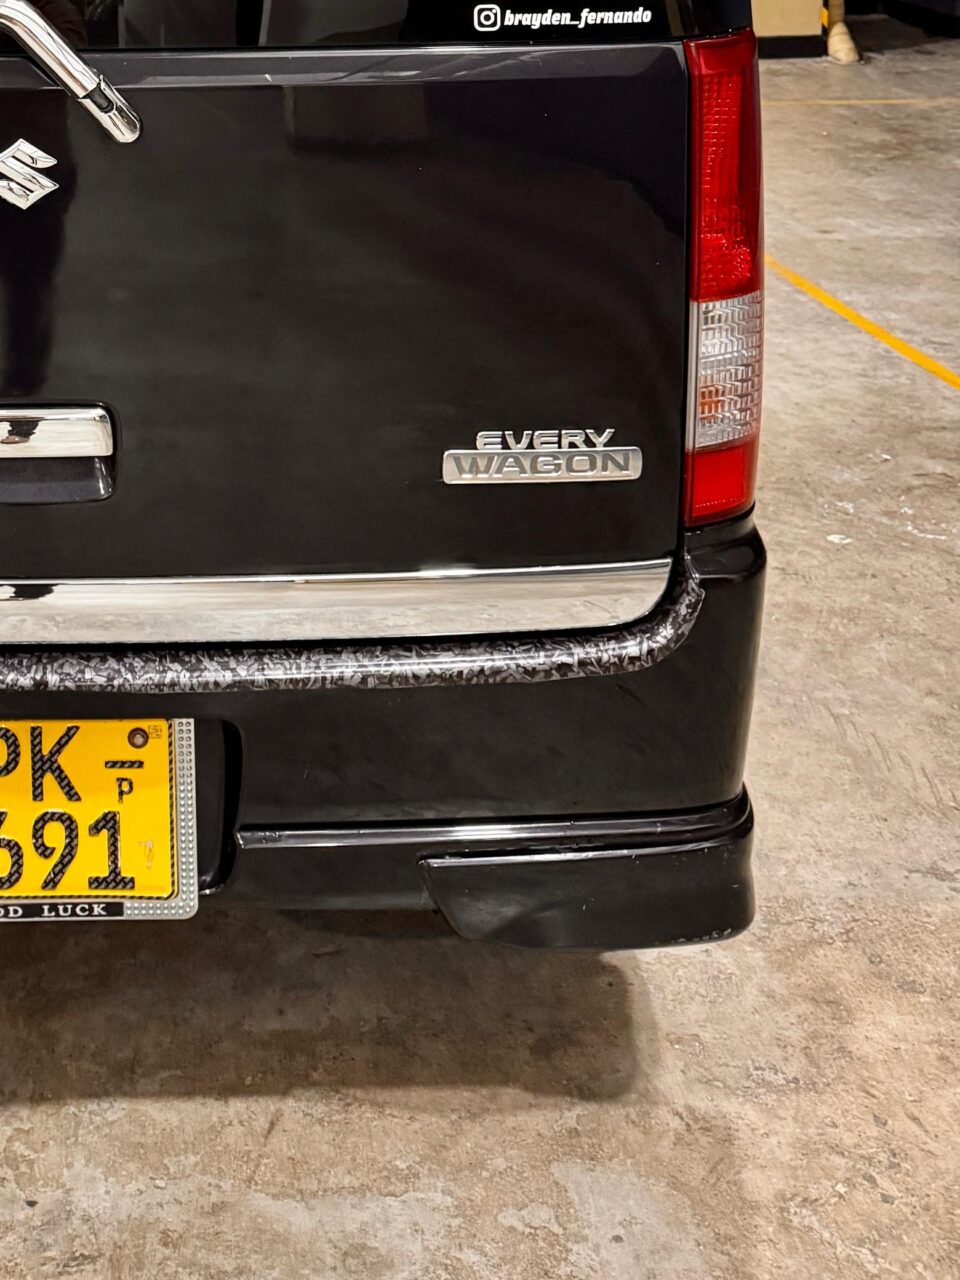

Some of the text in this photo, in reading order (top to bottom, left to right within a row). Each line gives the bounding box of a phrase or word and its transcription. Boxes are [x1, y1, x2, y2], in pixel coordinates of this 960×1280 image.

[503, 6, 652, 30] brayden_fernando
[475, 428, 616, 451] EVERY
[452, 451, 632, 478] WAGON
[41, 903, 108, 918] LUCK
